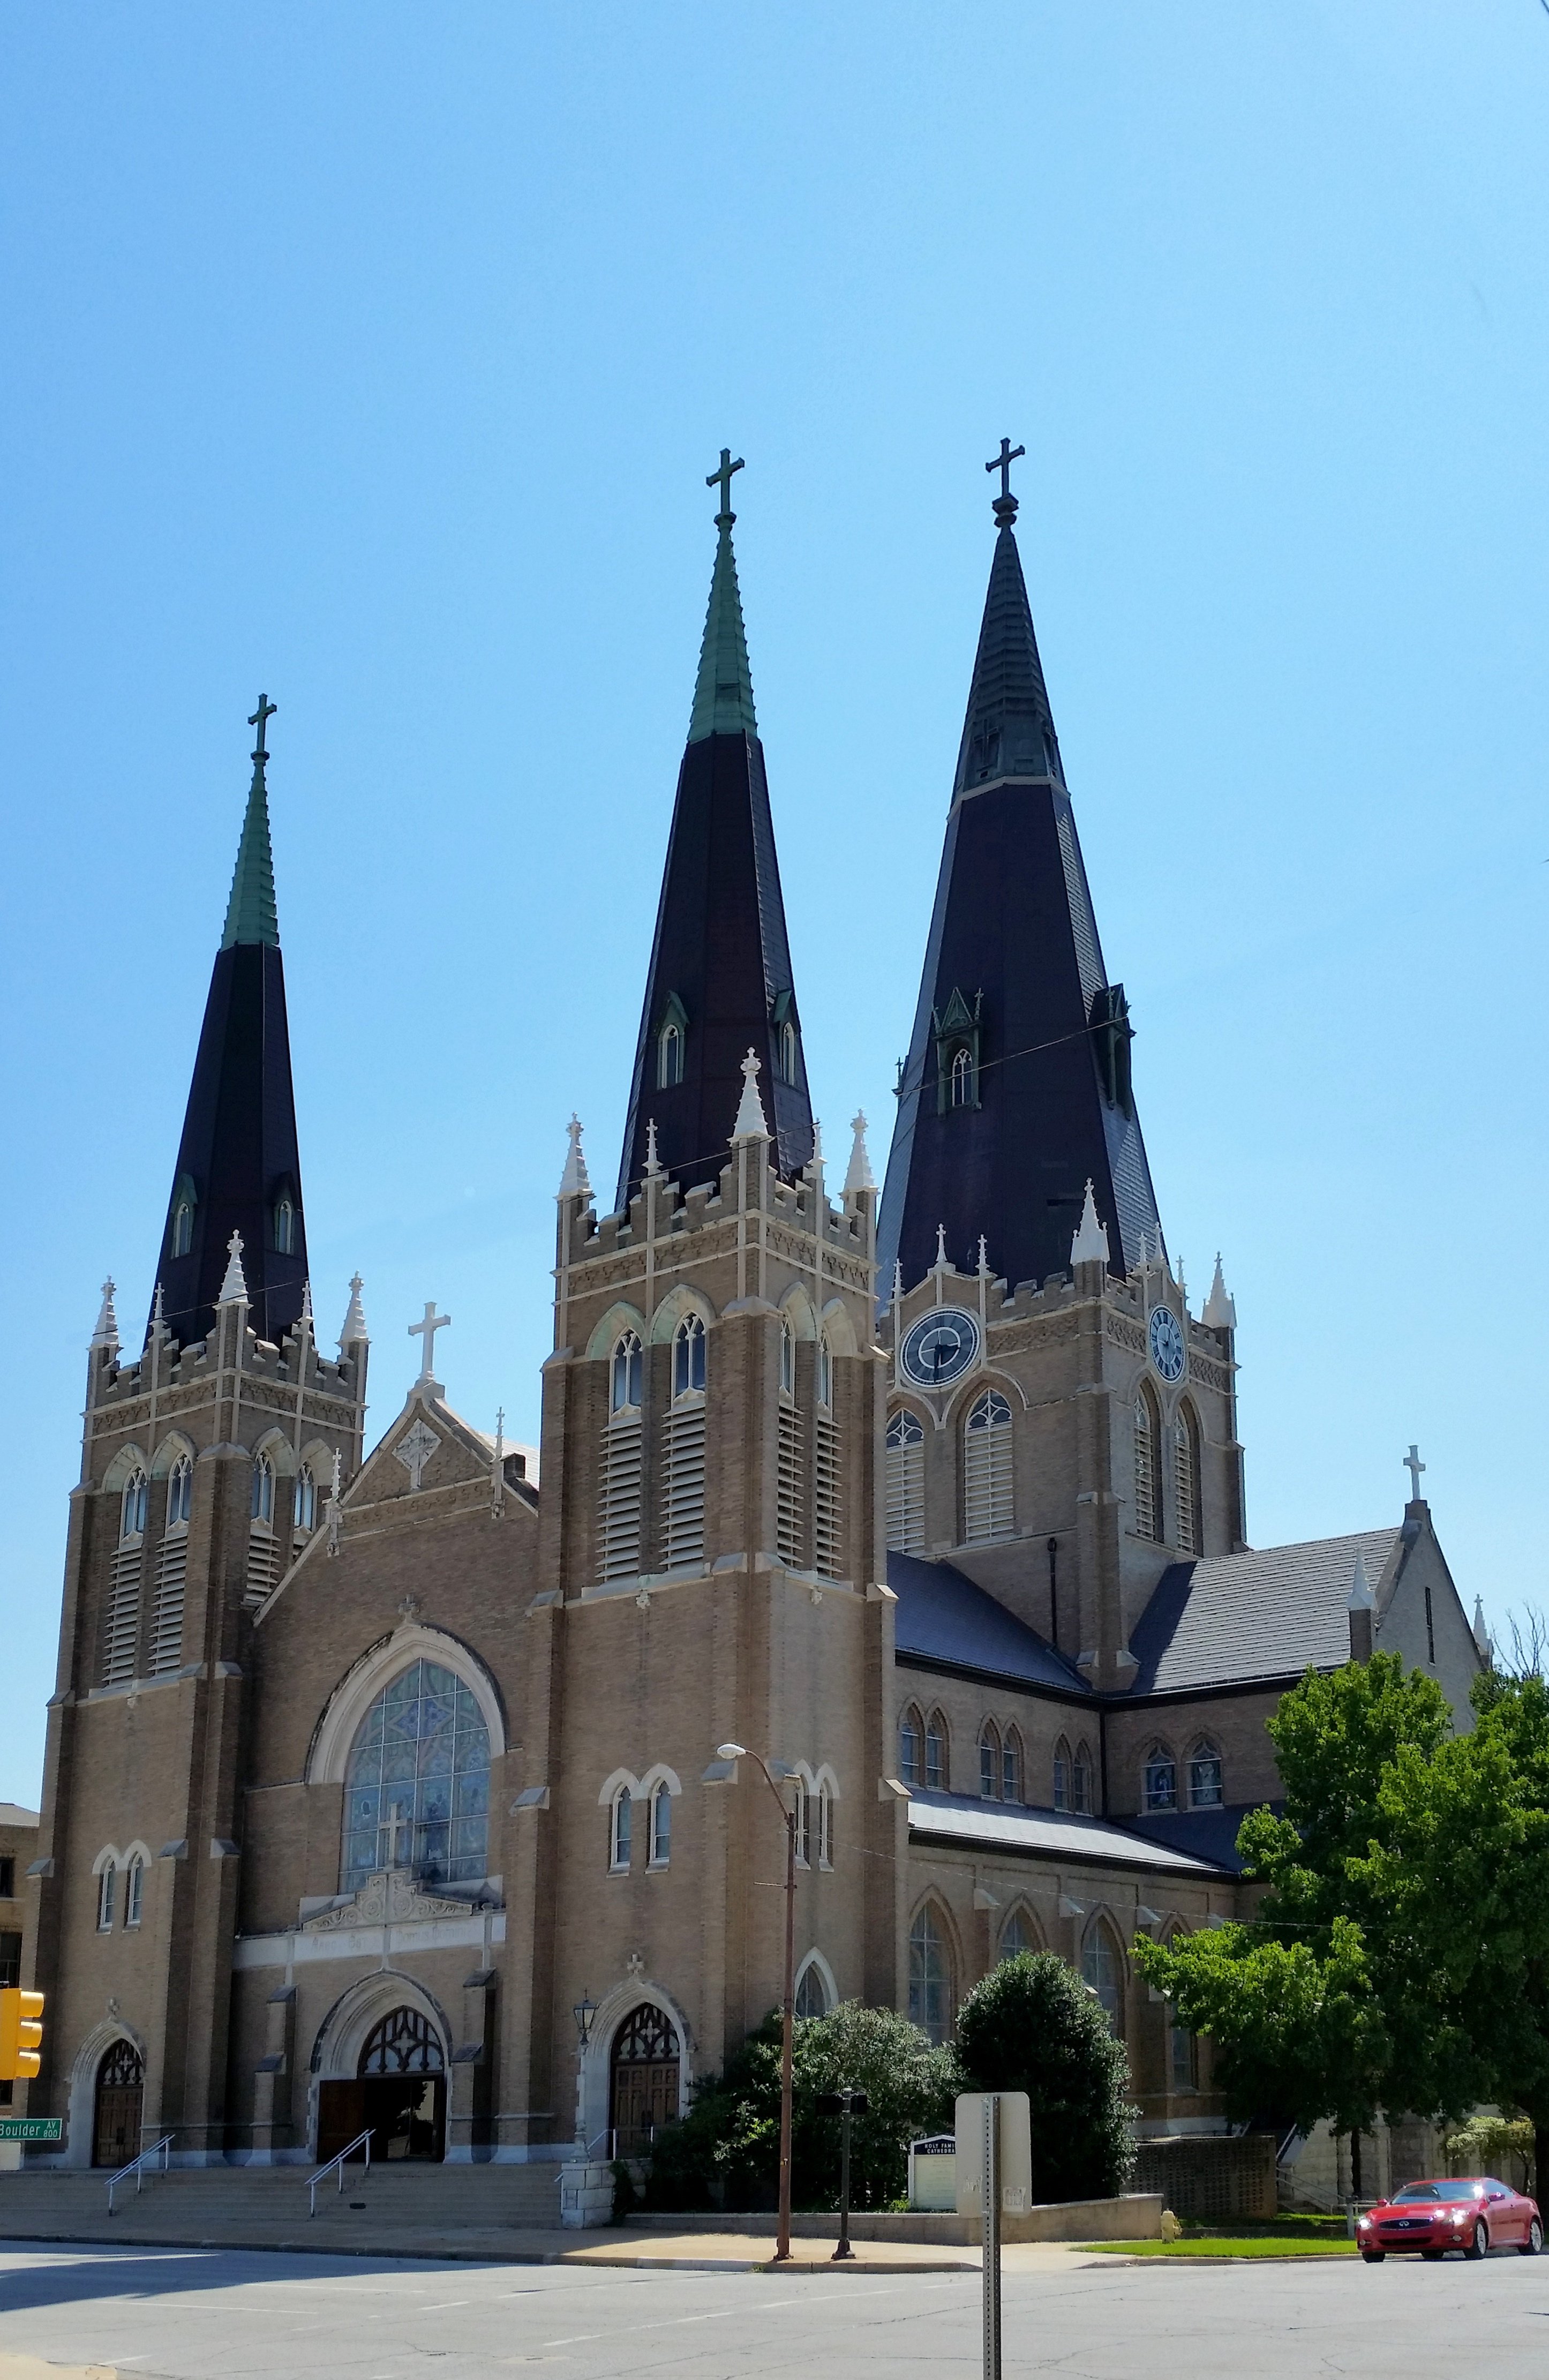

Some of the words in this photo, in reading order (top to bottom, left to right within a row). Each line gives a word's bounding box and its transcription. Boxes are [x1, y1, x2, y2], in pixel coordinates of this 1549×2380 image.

[47, 2121, 56, 2129] AV
[0, 2123, 40, 2136] Boulder
[43, 2129, 57, 2137] 800
